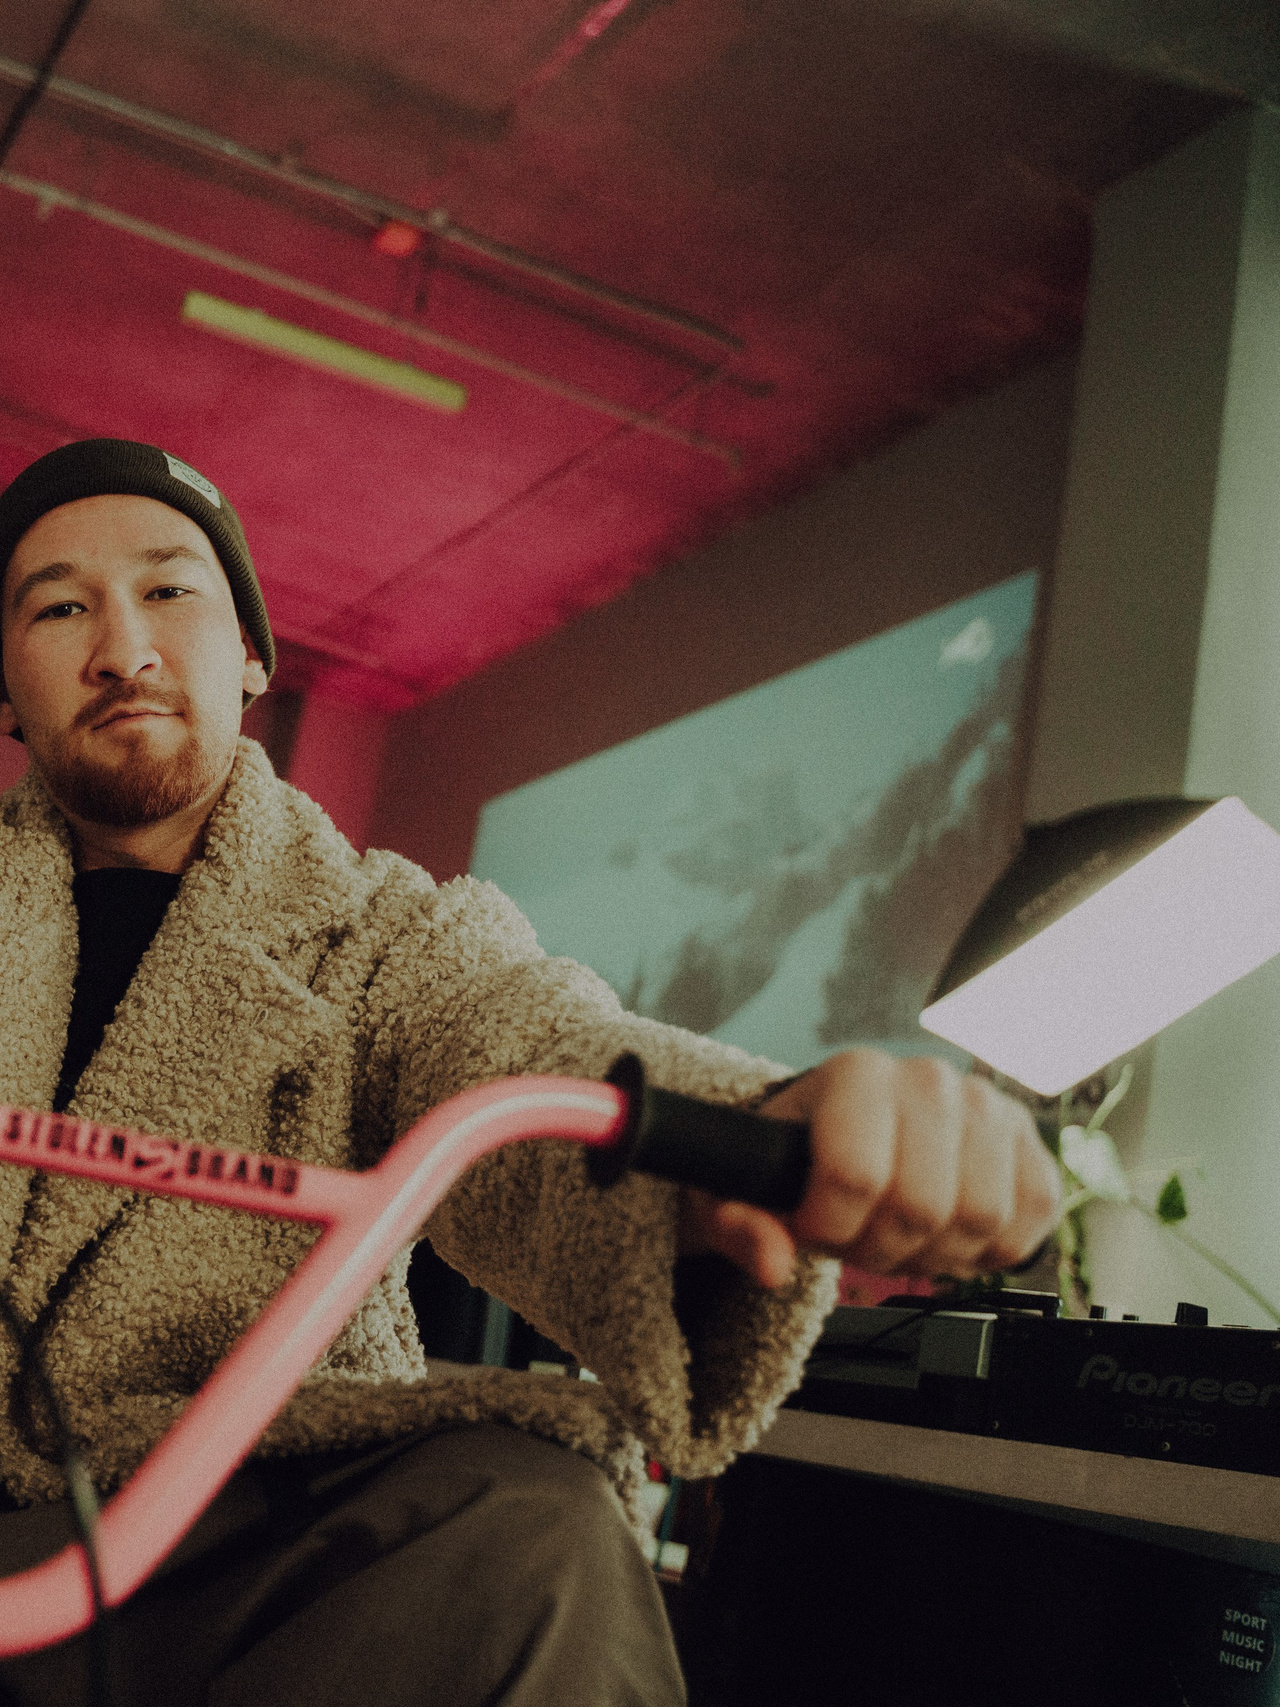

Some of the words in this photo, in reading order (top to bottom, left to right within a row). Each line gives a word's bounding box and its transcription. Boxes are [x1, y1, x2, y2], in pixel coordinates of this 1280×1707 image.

[1076, 1354, 1280, 1407] Pioneer
[1224, 1608, 1267, 1631] SPORT
[1221, 1629, 1264, 1652] MUSIC
[1220, 1650, 1262, 1673] NIGHT
